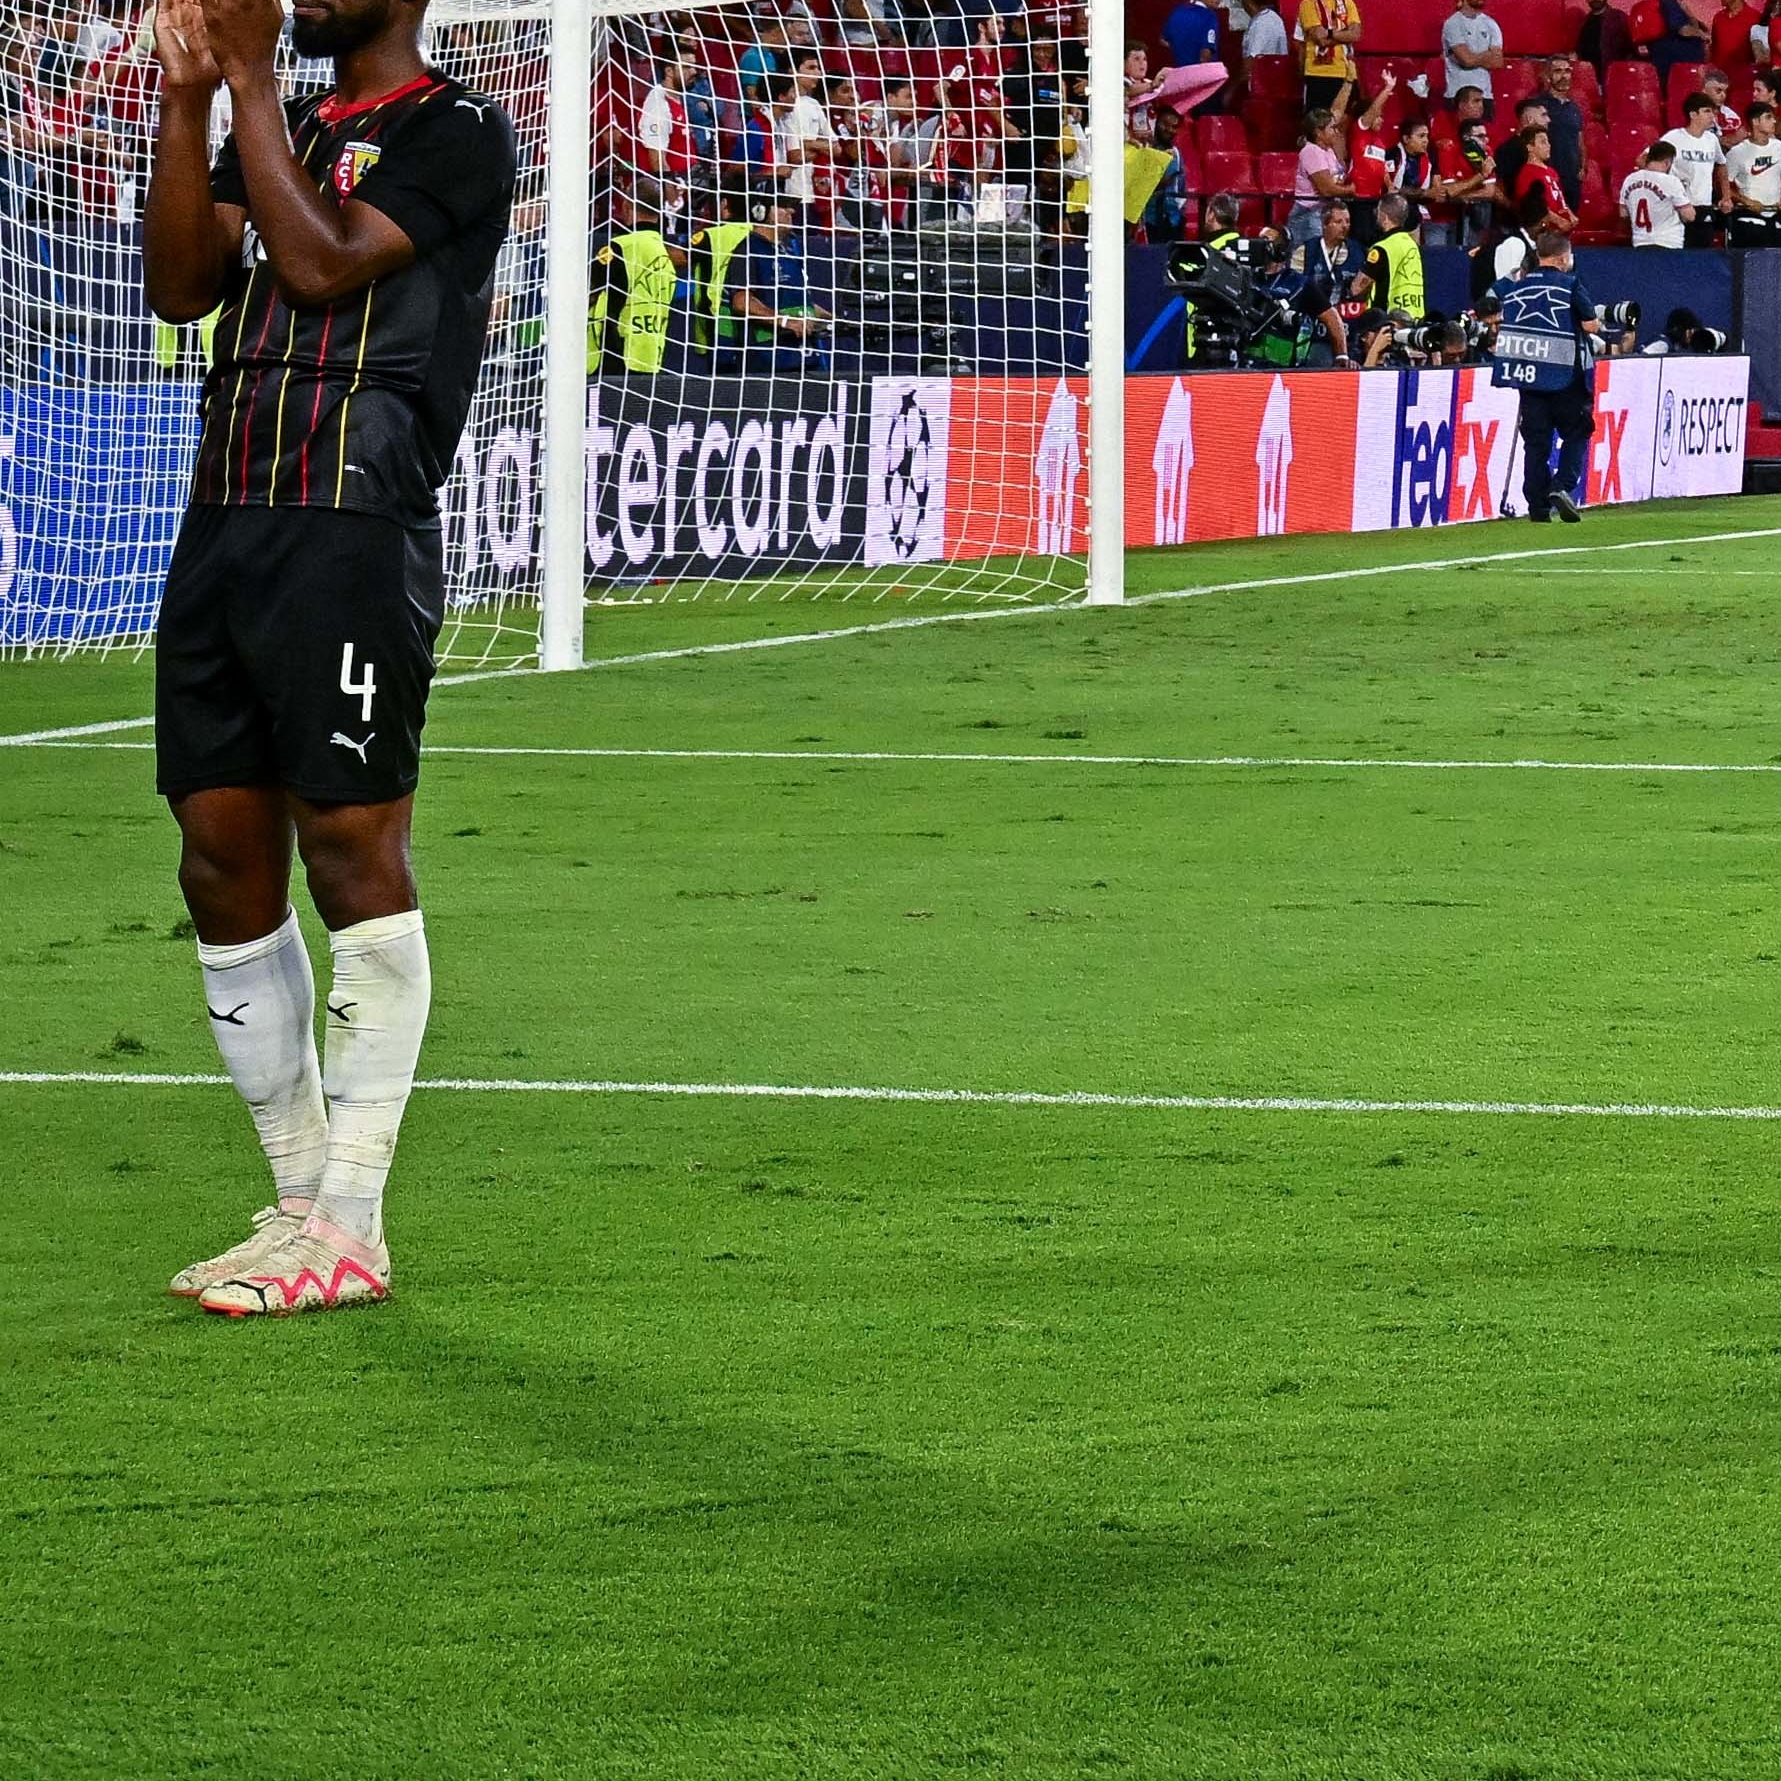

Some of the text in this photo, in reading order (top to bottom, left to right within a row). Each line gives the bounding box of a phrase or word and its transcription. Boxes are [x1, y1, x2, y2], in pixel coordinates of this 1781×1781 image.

[1754, 156, 1773, 168] NIKE
[1635, 198, 1652, 233] 4
[1496, 331, 1551, 359] PITCH
[1501, 362, 1537, 384] 148
[1679, 397, 1746, 458] RESPECT
[439, 380, 848, 574] matercard
[339, 642, 377, 722] 4
